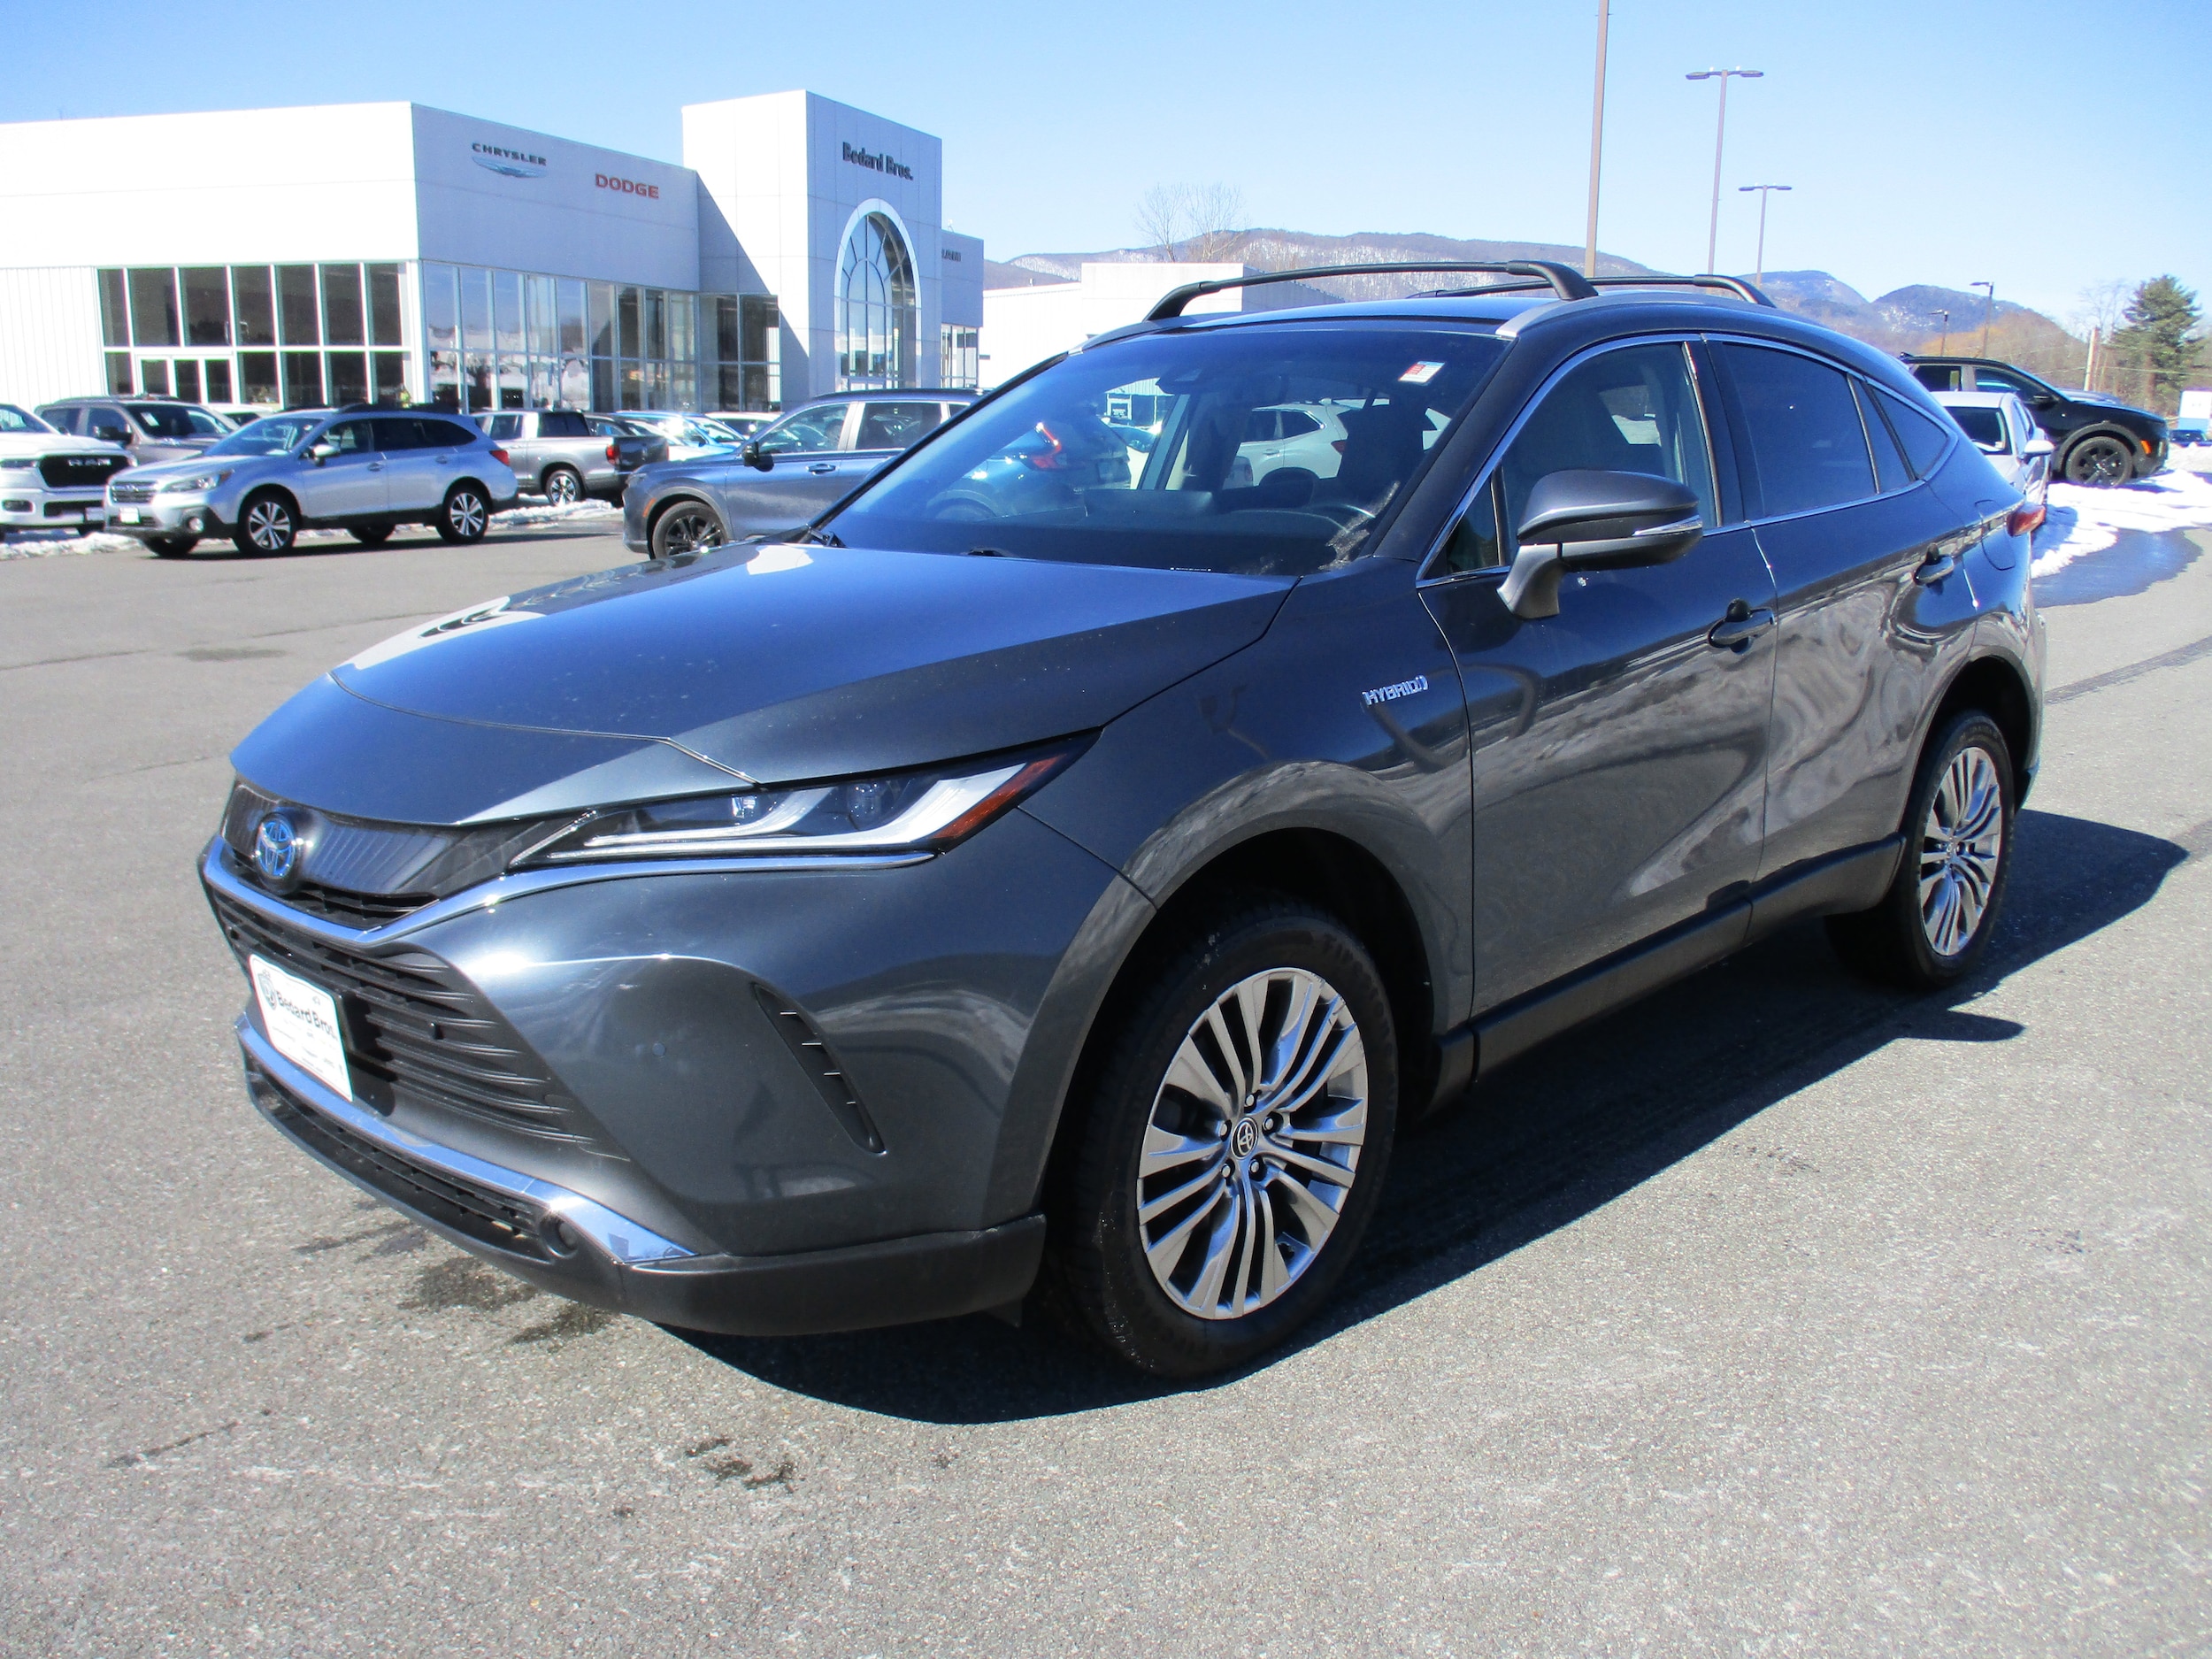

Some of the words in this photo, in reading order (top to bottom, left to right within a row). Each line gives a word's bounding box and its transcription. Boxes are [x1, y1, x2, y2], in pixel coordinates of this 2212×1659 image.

[472, 142, 547, 166] CHRYSLER
[842, 141, 884, 173] Bedard
[886, 154, 914, 180] Bros.
[595, 173, 659, 199] DODGE
[1362, 676, 1427, 706] HYBRID
[276, 990, 312, 1025] Bedard
